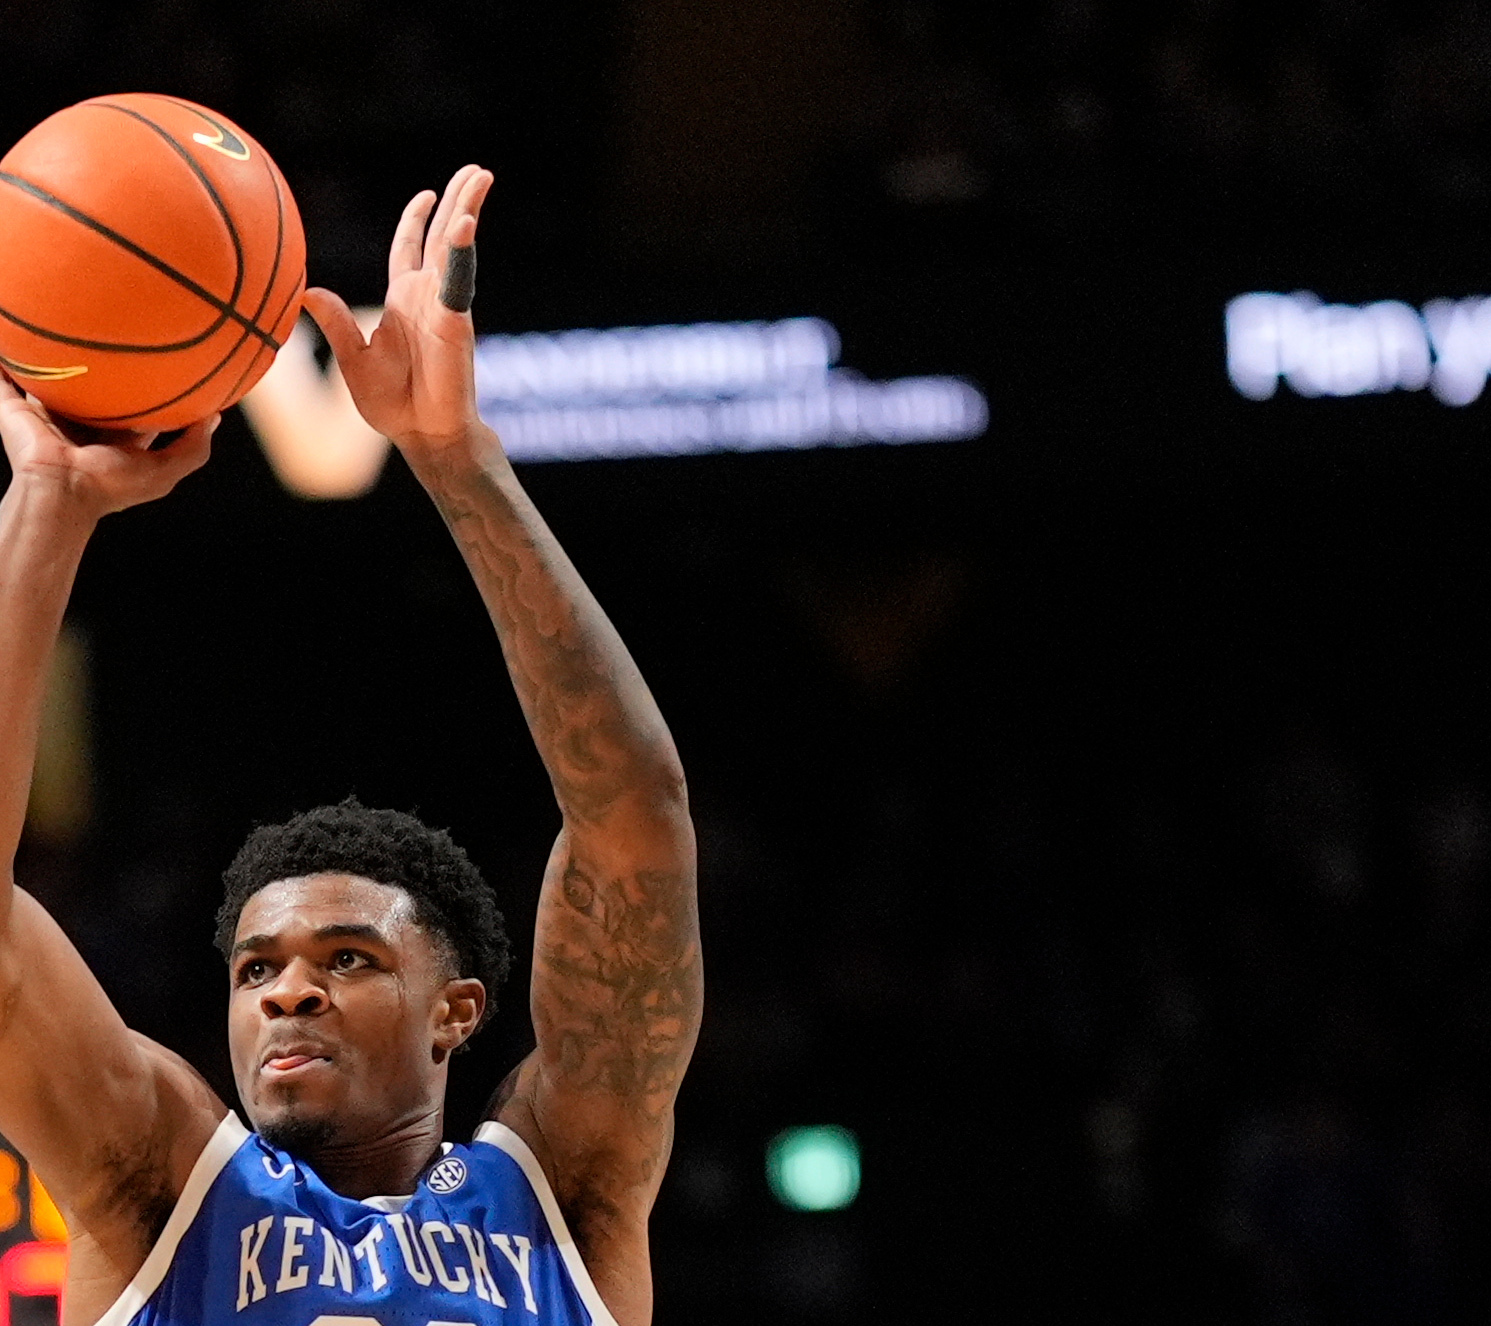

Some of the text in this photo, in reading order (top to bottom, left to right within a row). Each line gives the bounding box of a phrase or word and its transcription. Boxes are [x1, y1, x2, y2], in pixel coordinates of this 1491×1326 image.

[1226, 293, 1427, 397] Plan
[429, 1161, 463, 1190] SEC
[235, 1212, 538, 1315] KENTUCKY
